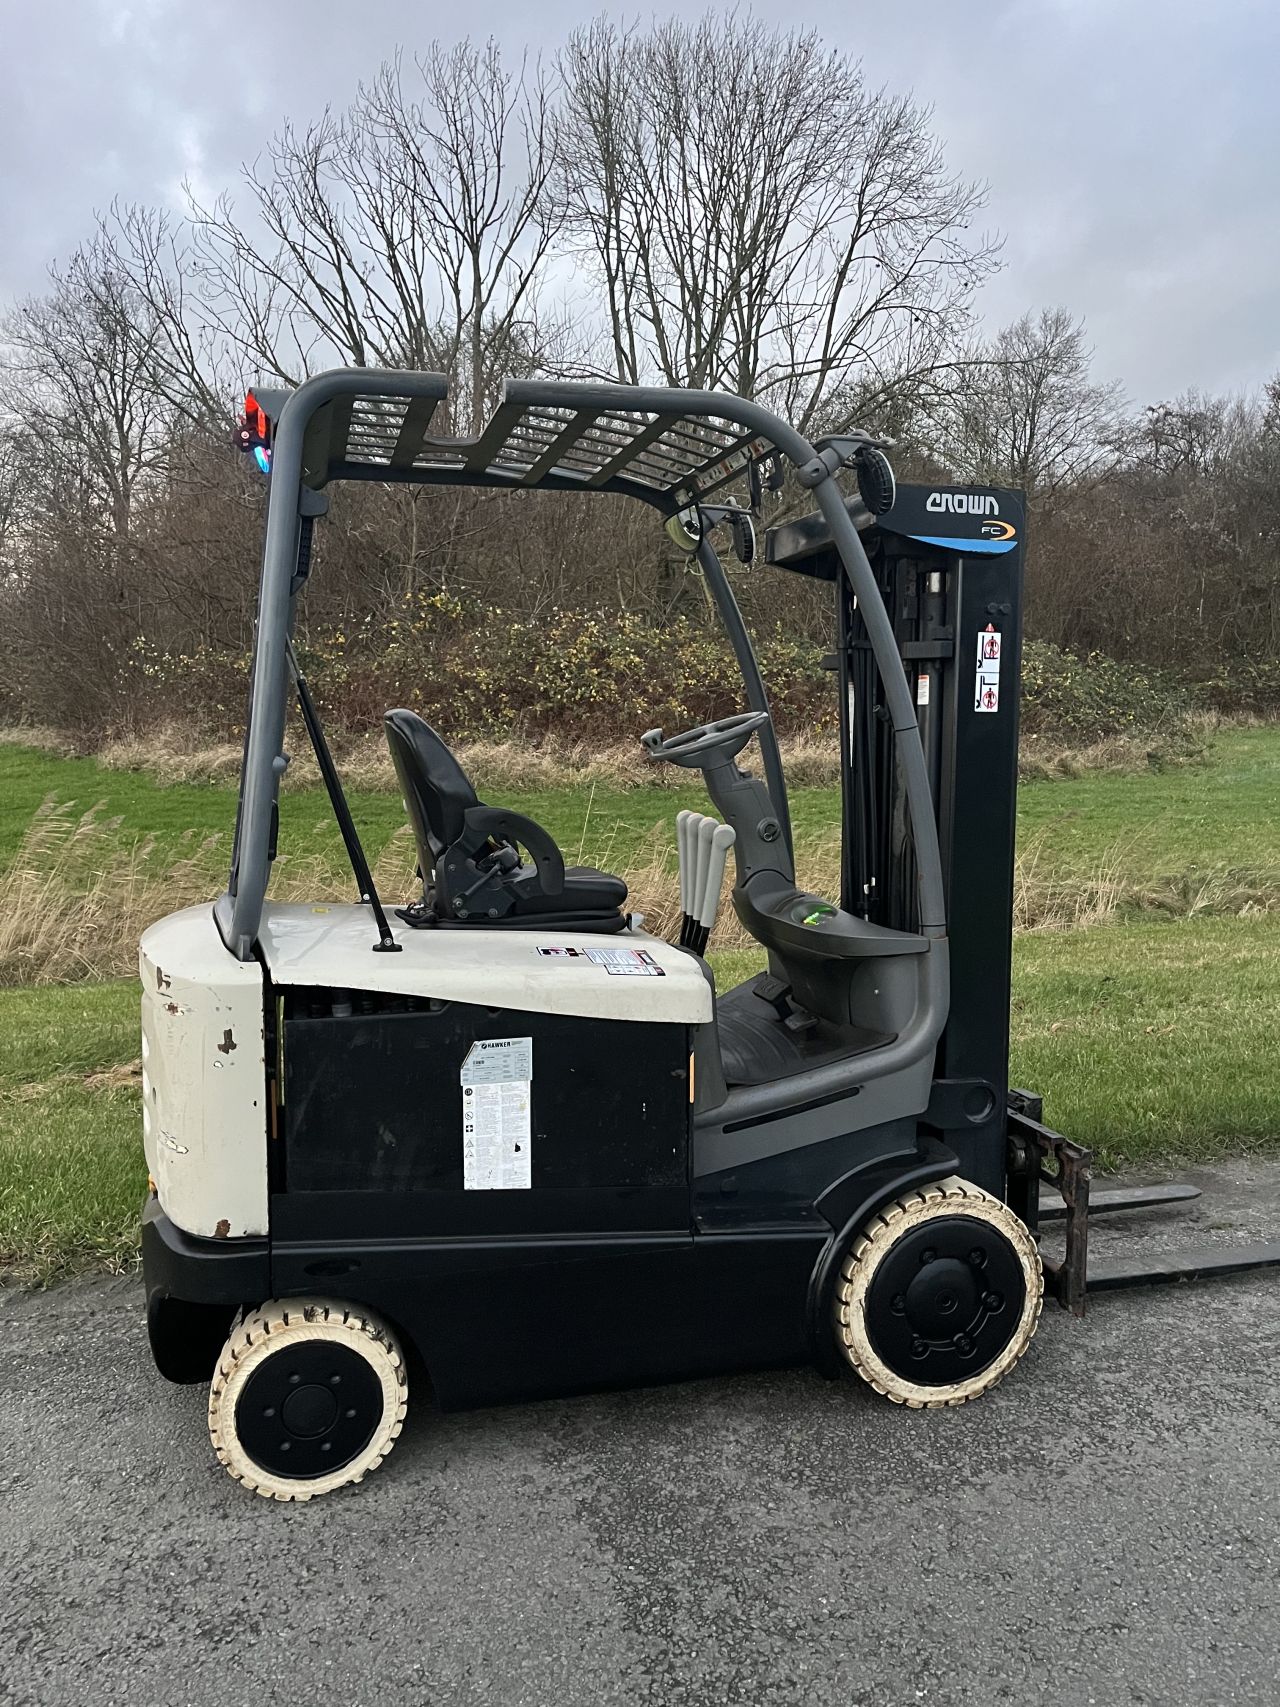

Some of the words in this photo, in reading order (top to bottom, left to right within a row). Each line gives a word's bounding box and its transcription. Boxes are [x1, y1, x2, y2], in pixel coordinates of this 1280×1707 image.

[926, 492, 999, 516] CROWN
[981, 526, 1001, 535] FC
[487, 1041, 511, 1049] HAWKER
